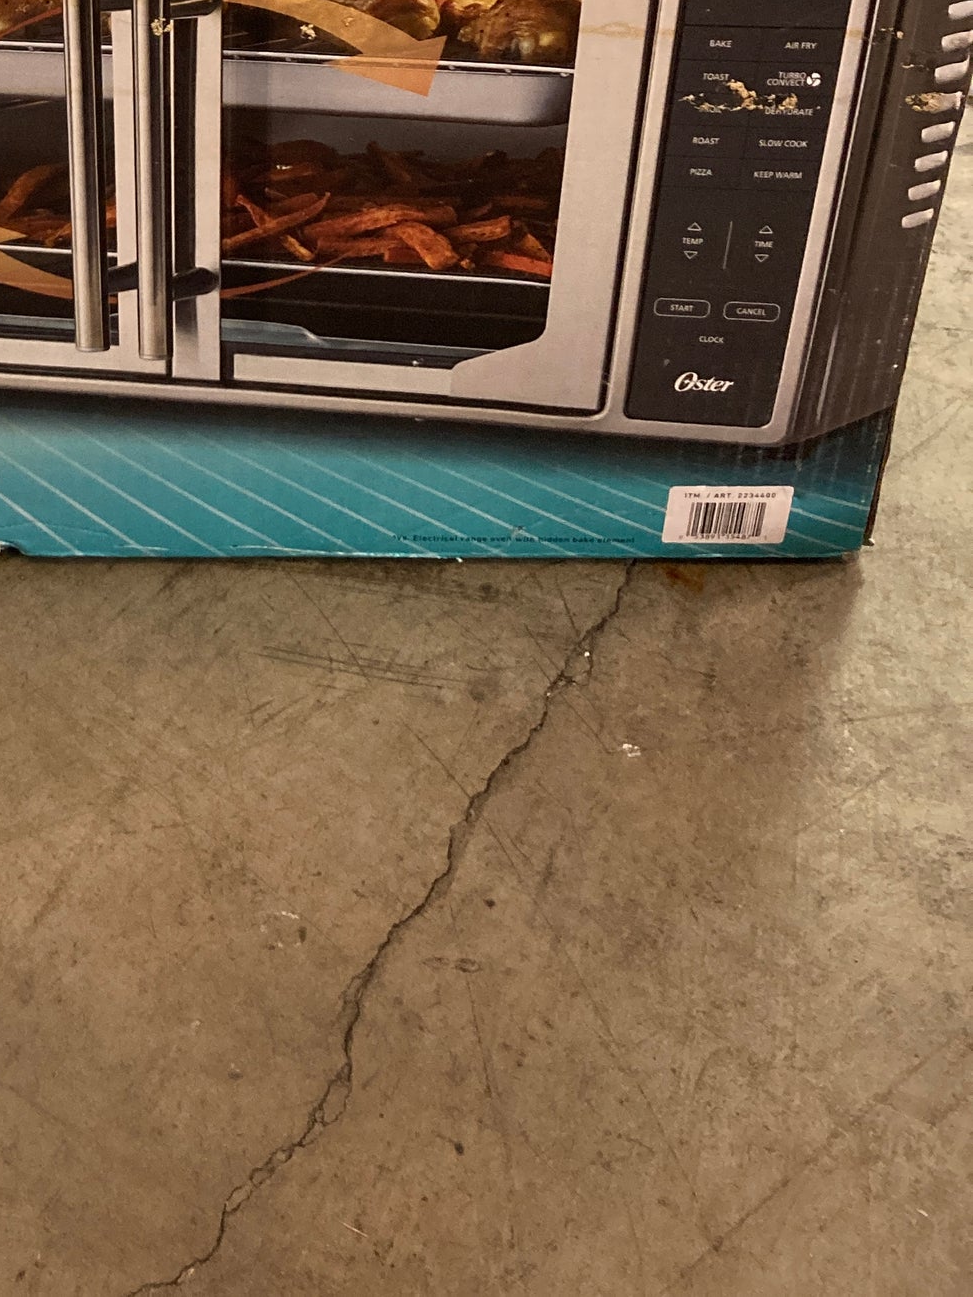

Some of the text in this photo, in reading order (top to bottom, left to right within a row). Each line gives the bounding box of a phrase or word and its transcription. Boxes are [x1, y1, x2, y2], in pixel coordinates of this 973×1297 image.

[709, 39, 733, 49] BAKE
[784, 41, 818, 50] AIR FRY
[702, 72, 730, 82] TOAST
[778, 71, 807, 80] TURBO
[766, 78, 806, 87] CONVECT
[692, 136, 720, 146] ROAST
[758, 139, 808, 148] SLOW COOK
[690, 168, 713, 177] PIZZA
[753, 171, 802, 180] KEEP WARM
[682, 237, 704, 246] TEMP
[754, 240, 774, 249] TIME
[670, 304, 694, 313] START
[736, 307, 767, 316] CANCEL
[698, 335, 725, 344] CLOCK
[674, 371, 735, 392] Oster
[412, 534, 458, 542] Electrical
[538, 535, 570, 543] hidden
[572, 535, 596, 543] bake
